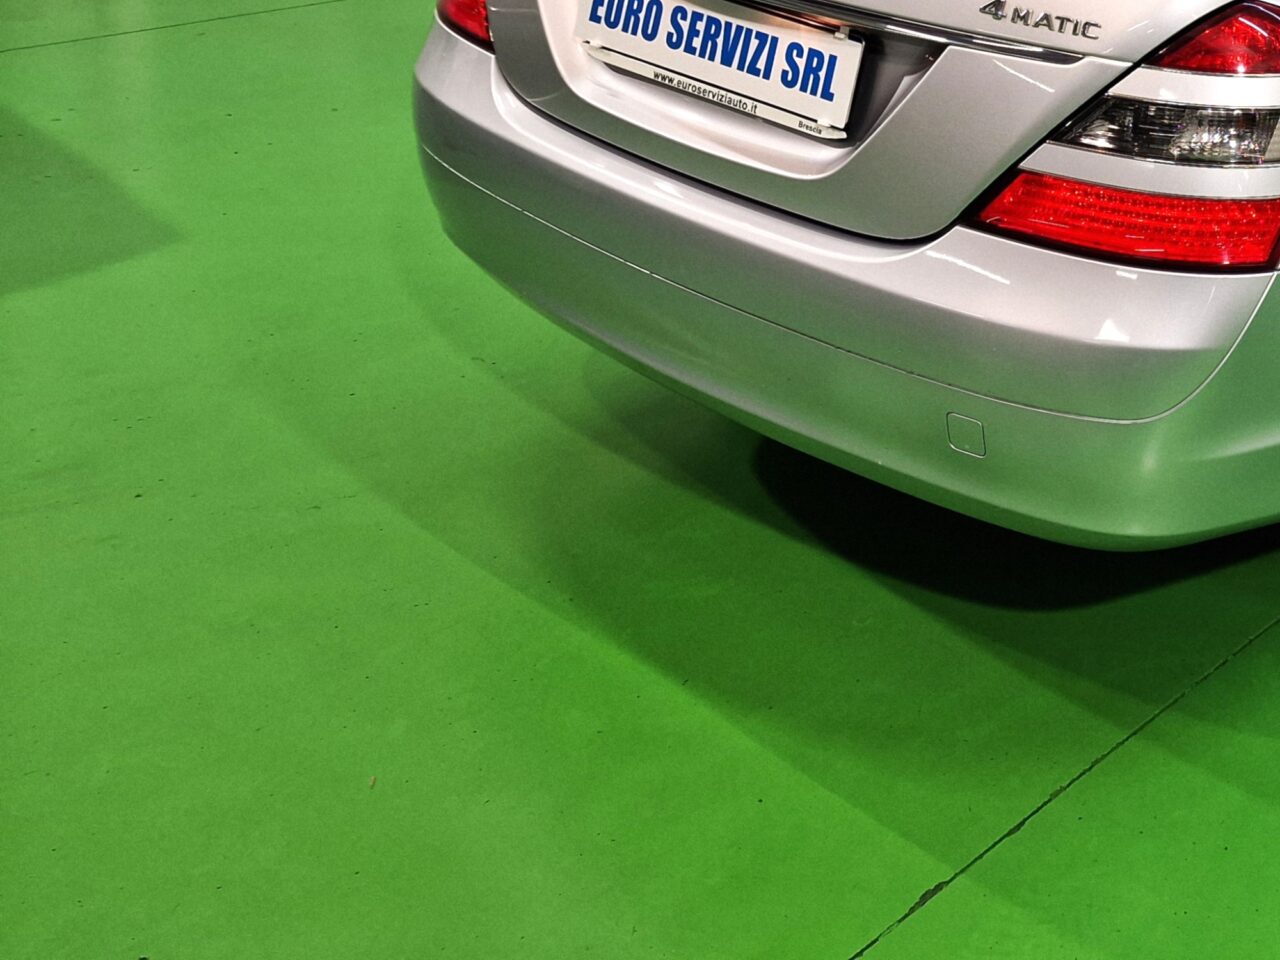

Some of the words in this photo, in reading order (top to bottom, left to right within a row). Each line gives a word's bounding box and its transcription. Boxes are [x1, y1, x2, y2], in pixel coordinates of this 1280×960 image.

[665, 5, 780, 81] SERVIZI
[780, 41, 838, 103] SRL
[653, 70, 758, 115] www.euroserviziauto.it
[797, 120, 823, 136] Brescia
